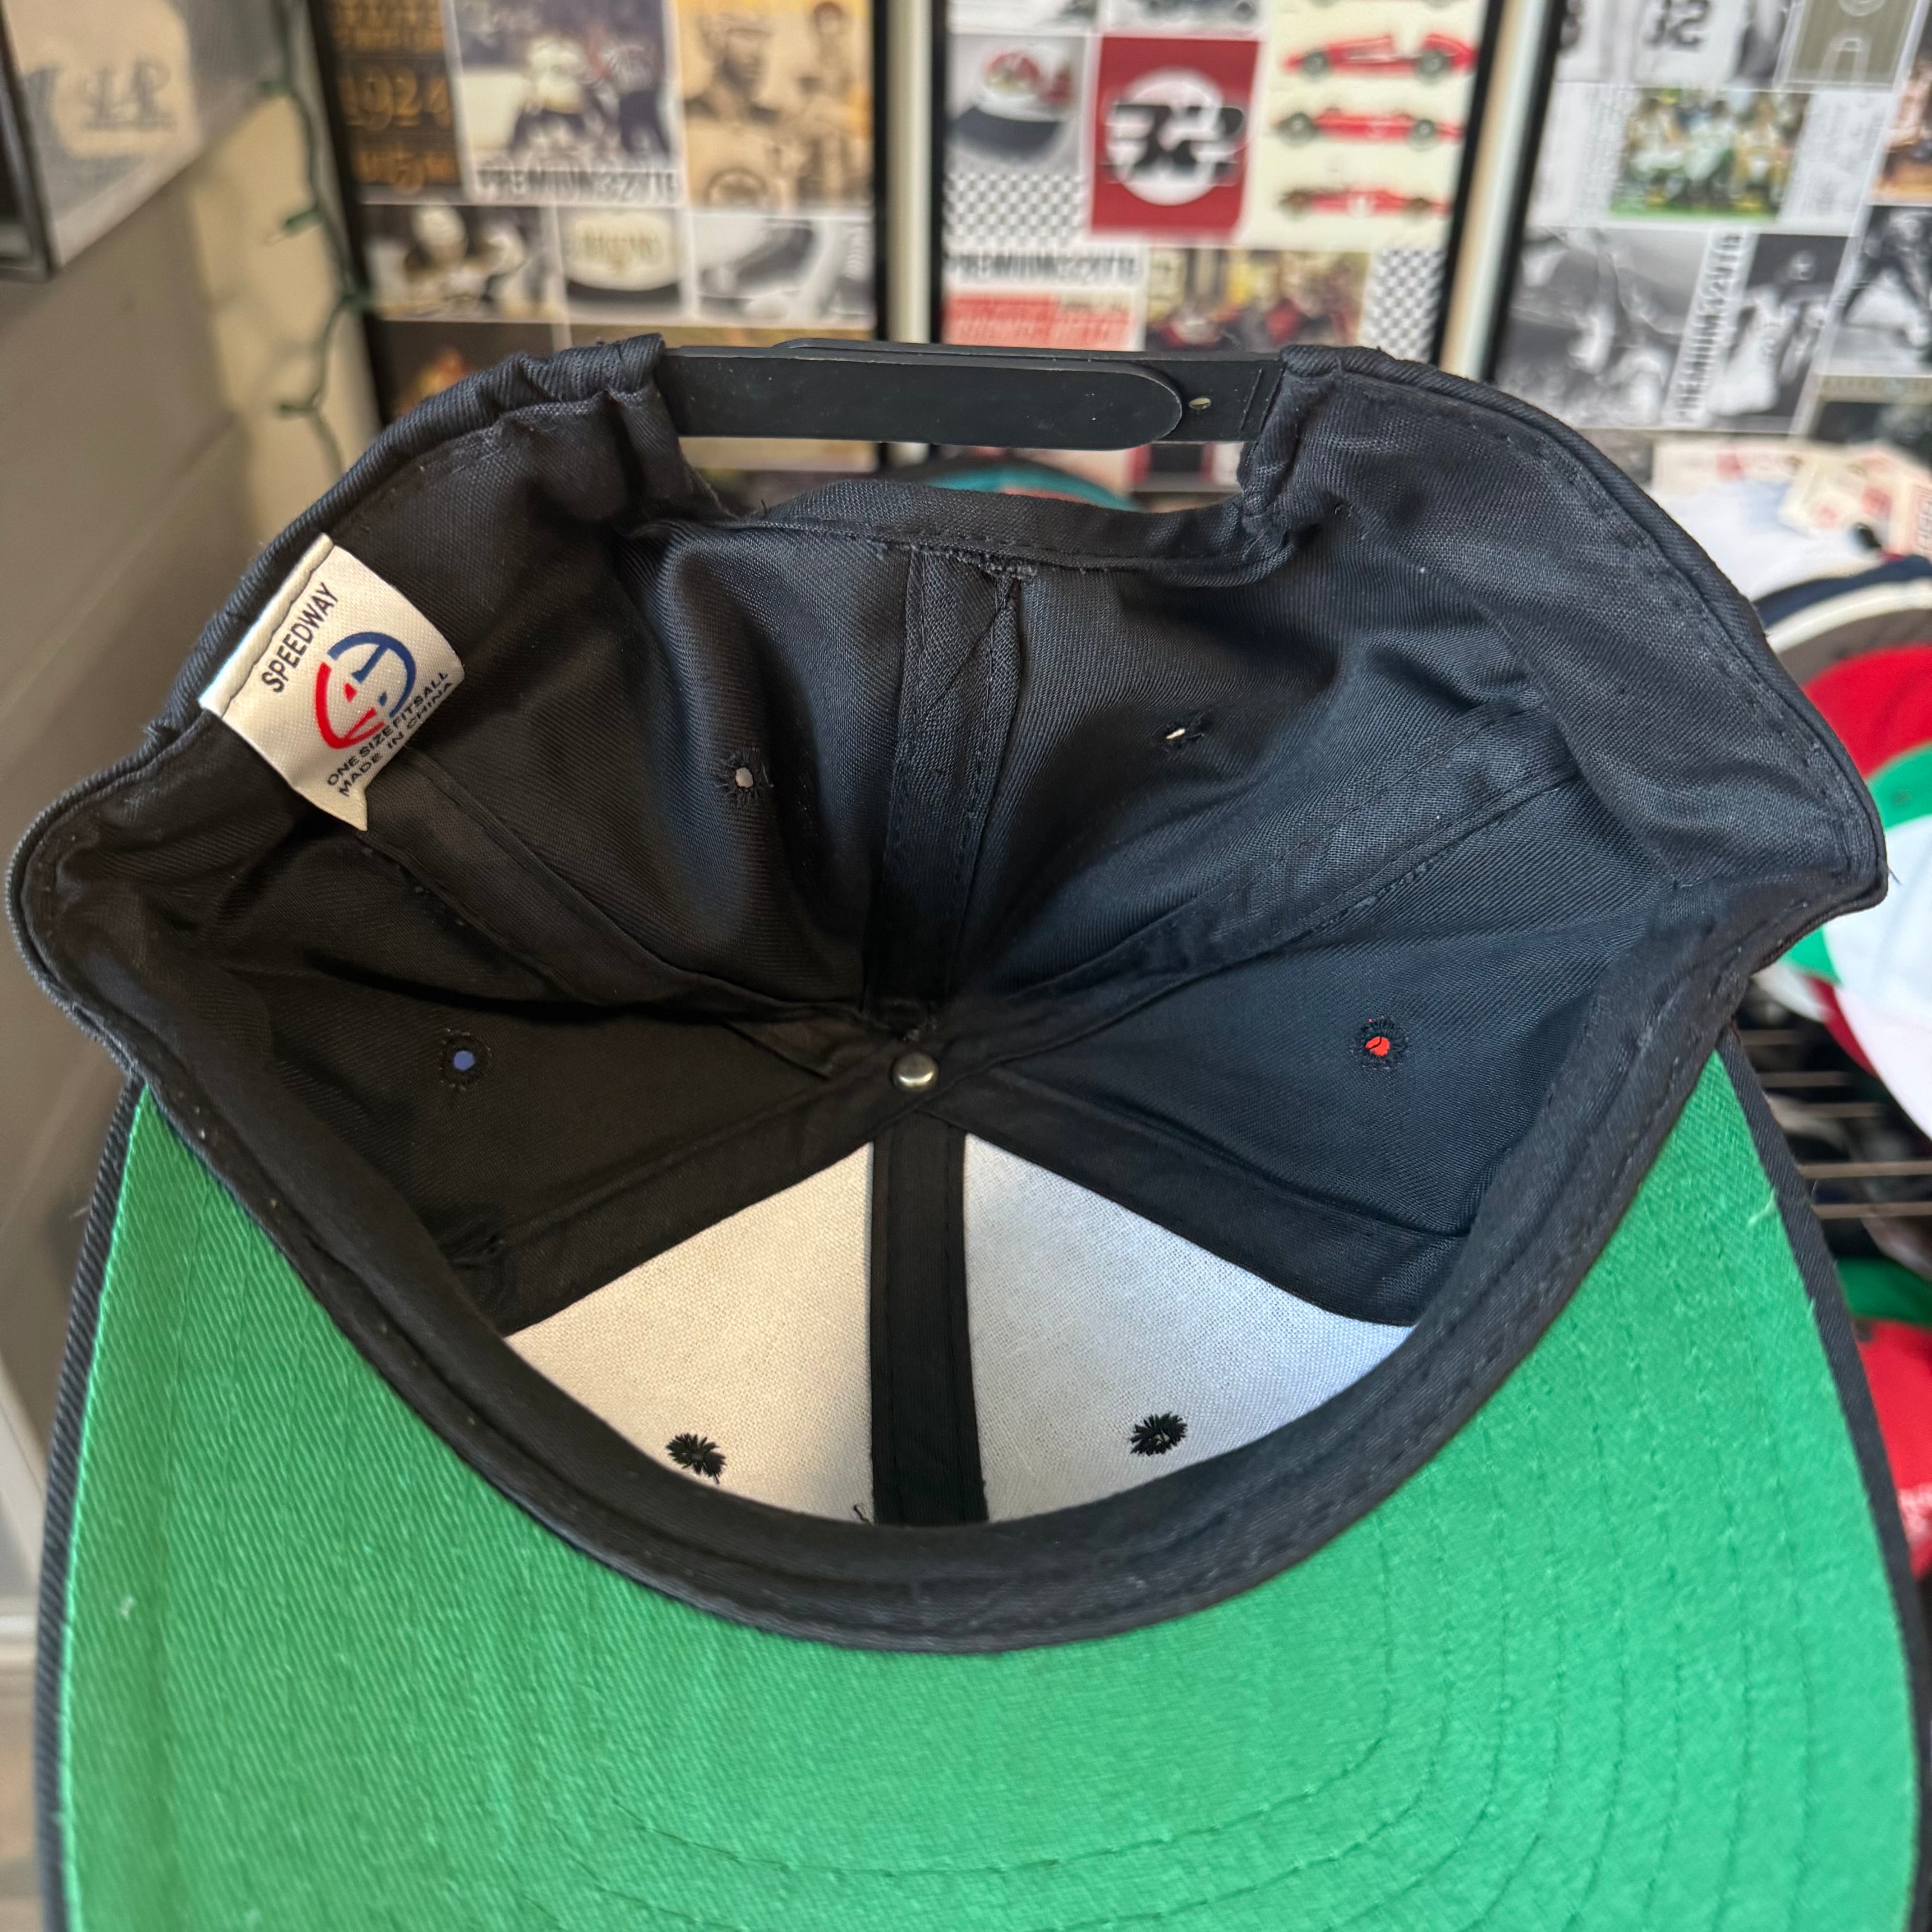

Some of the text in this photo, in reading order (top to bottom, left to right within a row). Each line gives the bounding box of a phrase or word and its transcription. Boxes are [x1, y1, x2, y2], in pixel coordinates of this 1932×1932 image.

[261, 582, 339, 693] SPEEDWAY
[327, 756, 360, 786] ONE
[359, 725, 394, 758] SIZE
[339, 682, 453, 797] MADE IN CHINA
